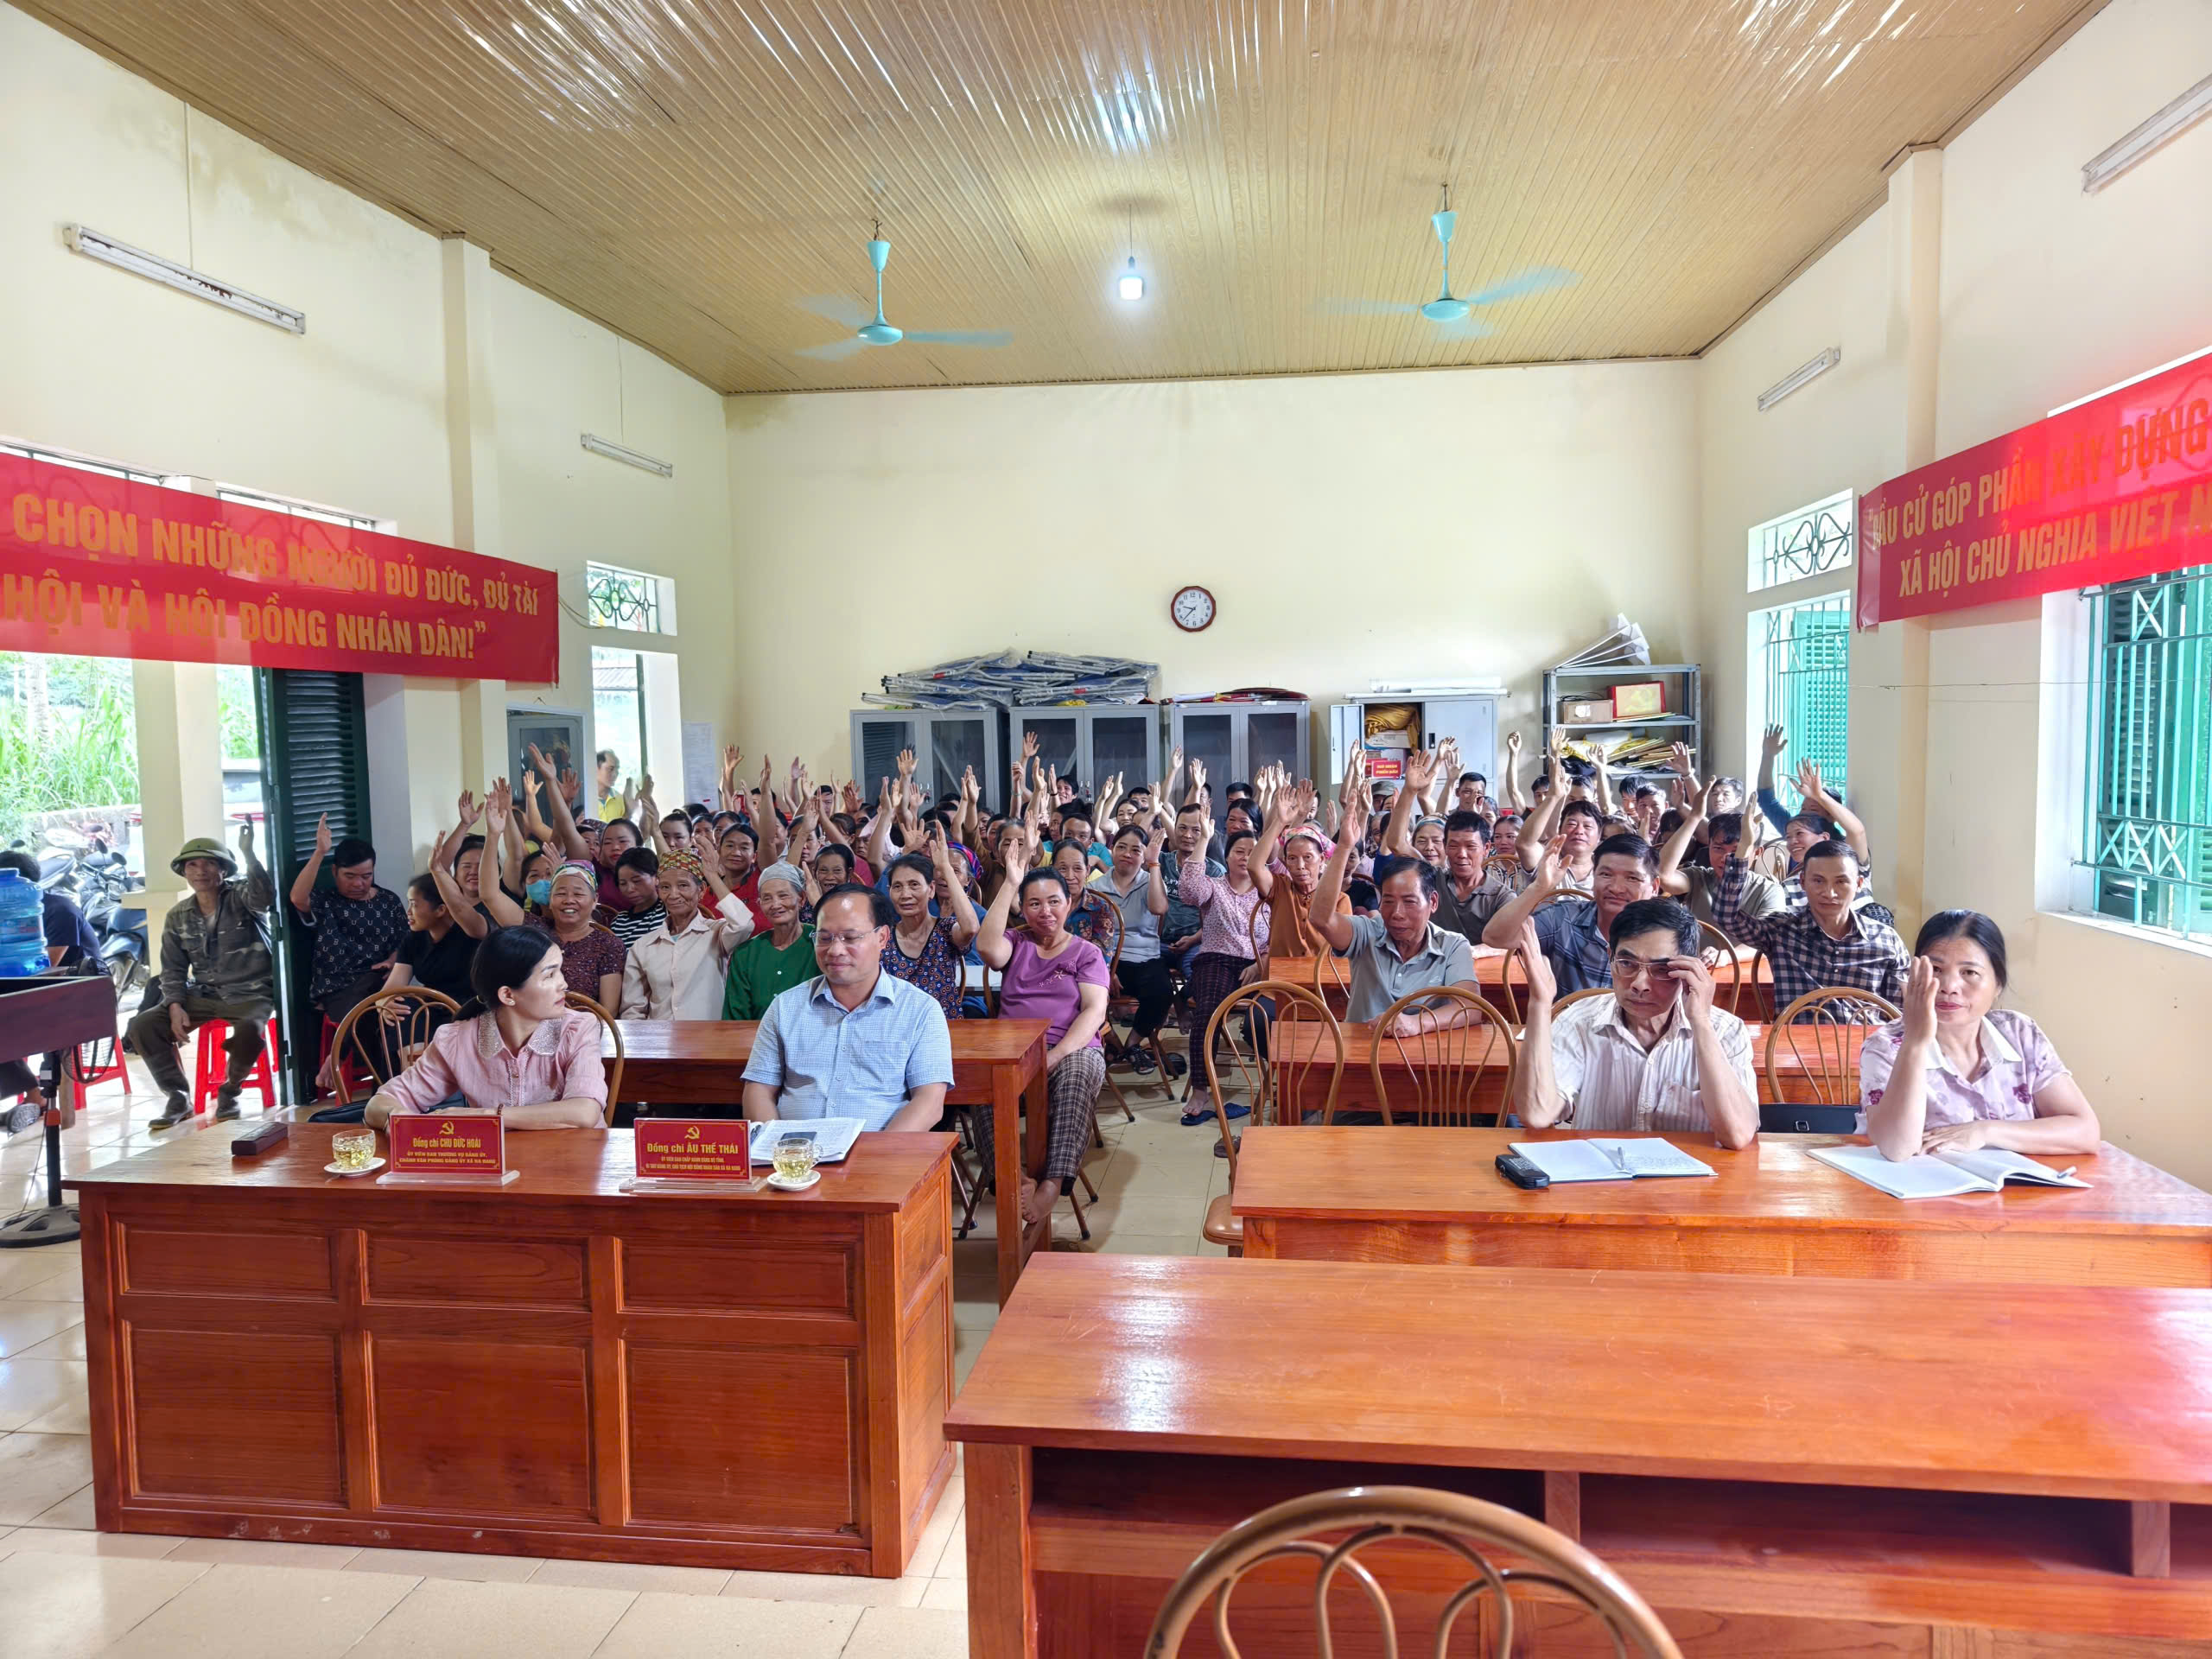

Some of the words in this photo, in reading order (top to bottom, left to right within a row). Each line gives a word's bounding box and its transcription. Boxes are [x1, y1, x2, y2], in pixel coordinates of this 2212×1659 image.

[1903, 484, 1929, 539] CỬ
[1932, 477, 1972, 531] GÓP
[13, 493, 138, 562] CHỌN
[152, 518, 277, 577] NHỮNG
[287, 542, 378, 593] NGƯỜI
[385, 554, 419, 598] ĐỦ
[425, 565, 479, 610] ĐỨC,
[484, 572, 510, 612] ĐỦ
[512, 580, 538, 616] TÀI
[1898, 549, 1923, 597] XÃ
[1928, 539, 1961, 598] HỘI
[1967, 518, 2012, 583] CHỦ
[3, 568, 83, 635] HỘI
[97, 578, 151, 636] VÀ
[165, 588, 226, 645] HỘI
[238, 592, 327, 647] ĐỒNG
[336, 611, 412, 654] NHÂN
[440, 1138, 452, 1147] CHU
[647, 1142, 669, 1154] Đồng
[671, 1142, 684, 1153] chí
[687, 1142, 699, 1153] ÂU
[700, 1142, 716, 1154] THẾ
[719, 1143, 739, 1154] THÁI
